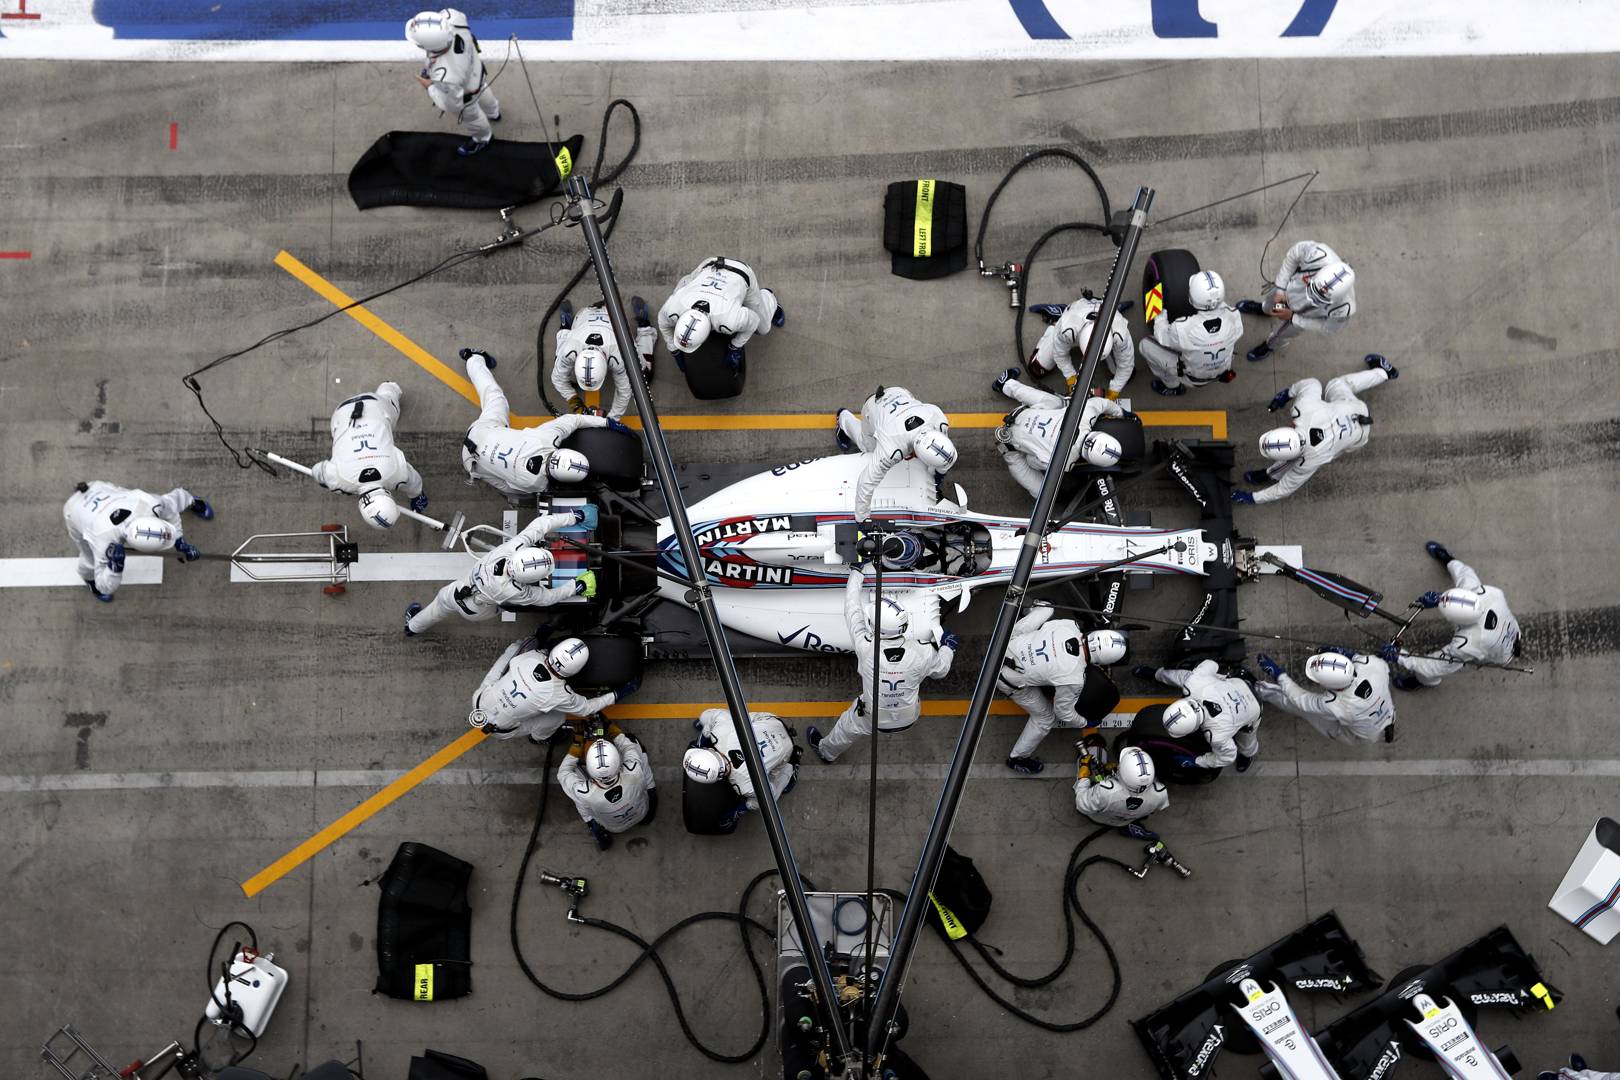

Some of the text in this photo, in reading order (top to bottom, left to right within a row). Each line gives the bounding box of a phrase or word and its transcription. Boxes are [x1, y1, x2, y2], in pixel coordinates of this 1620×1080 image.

[921, 180, 930, 202] FRONT
[918, 242, 926, 256] FRO
[1097, 478, 1115, 512] Reona
[698, 516, 791, 546] MARTIN
[1188, 536, 1196, 565] ORIS
[701, 557, 791, 584] ARTINI
[420, 978, 428, 999] REAR
[1252, 1001, 1281, 1022] ORIS
[1429, 1017, 1458, 1039] ORIS
[1188, 1033, 1221, 1077] Rexona
